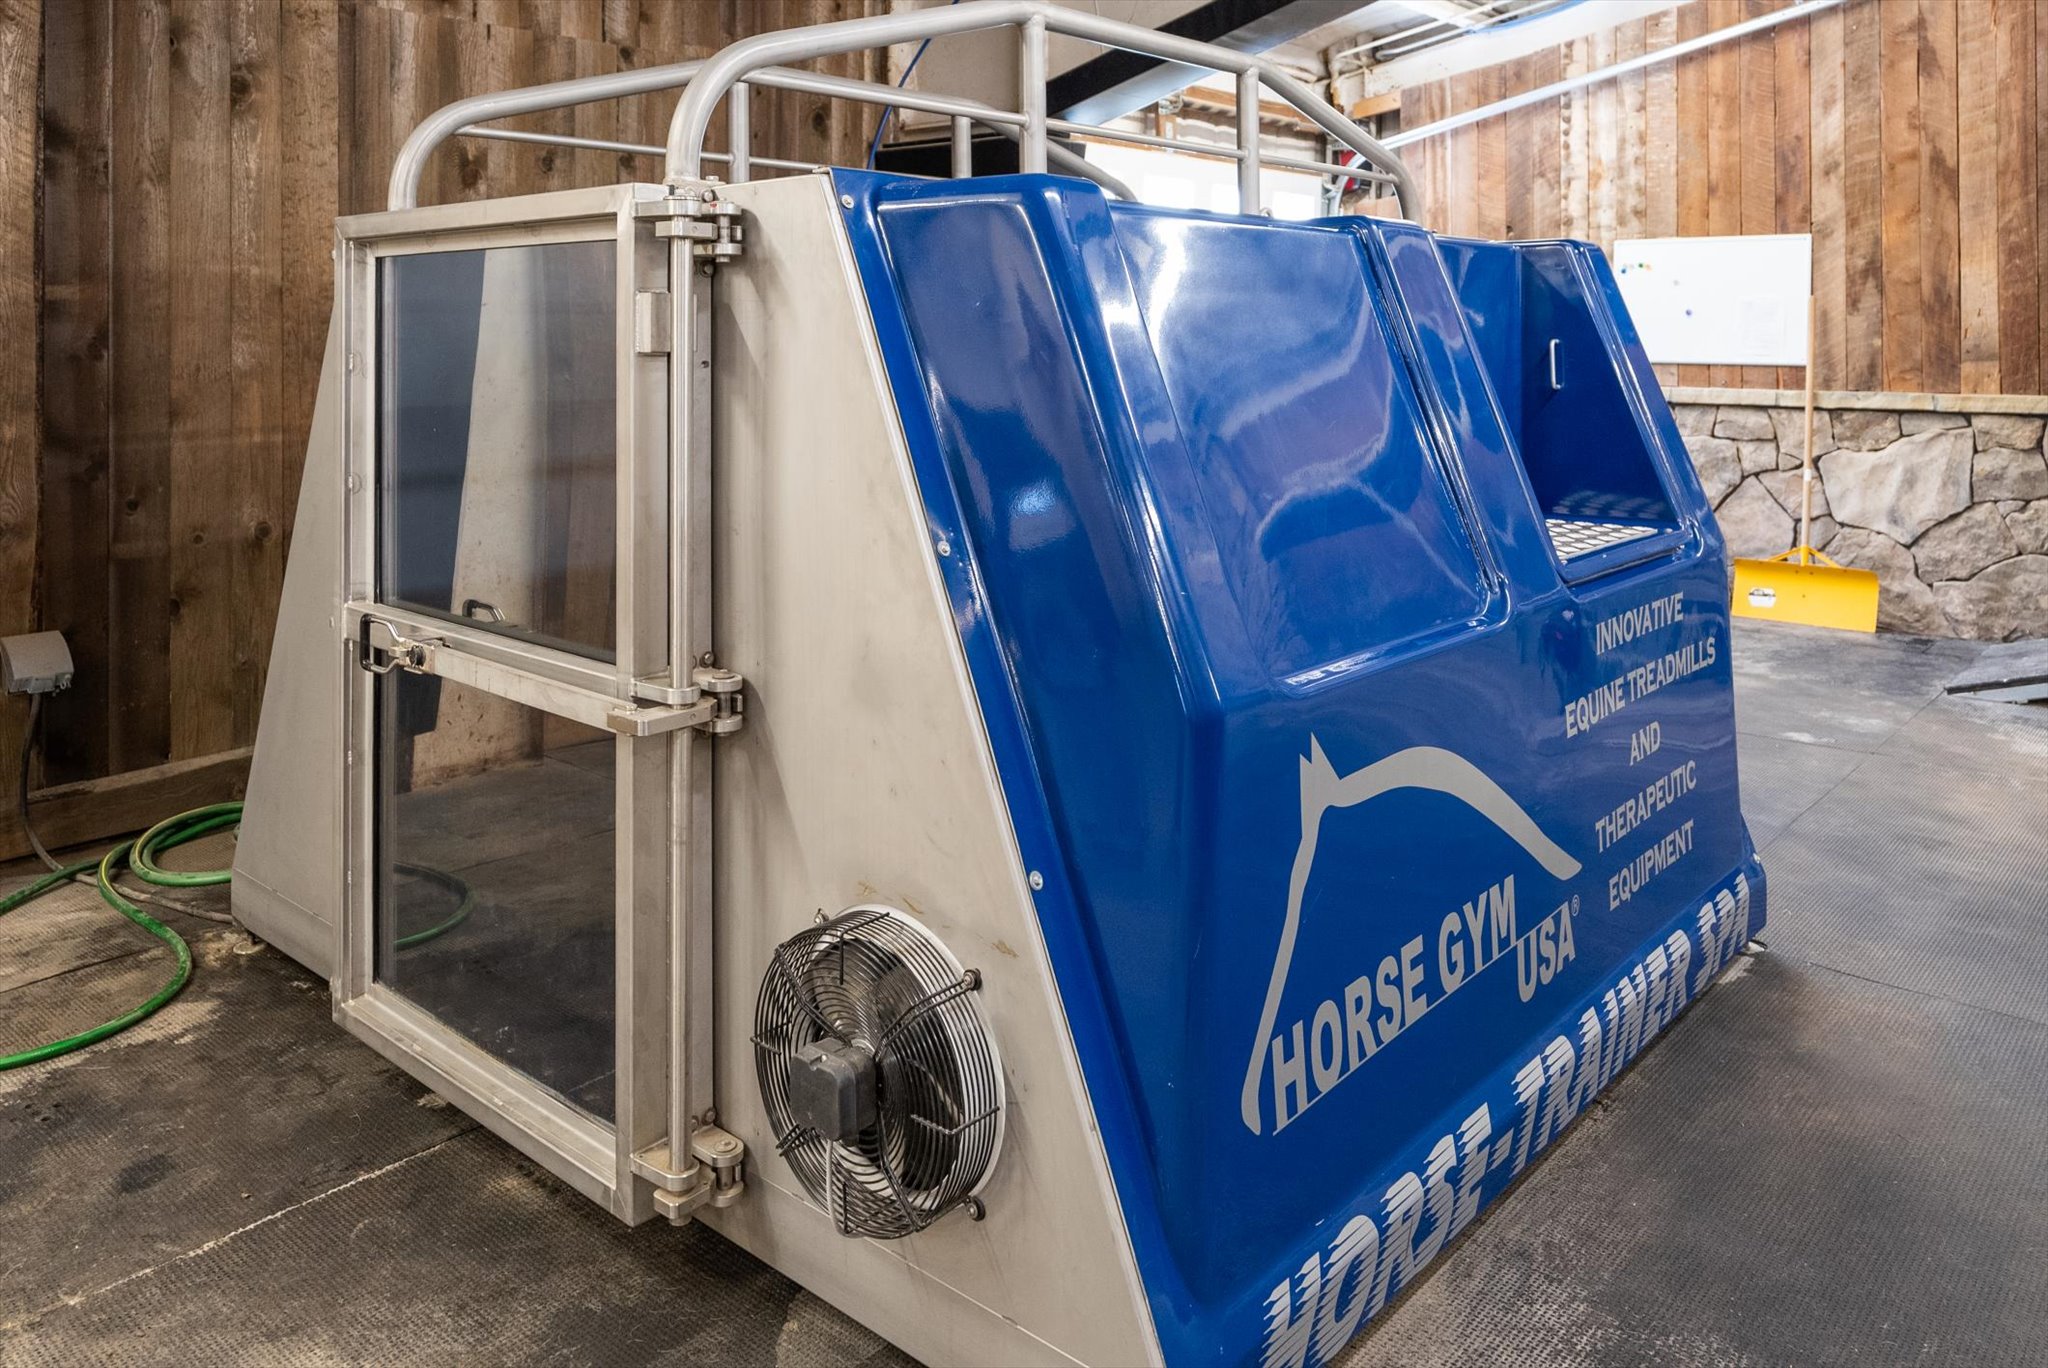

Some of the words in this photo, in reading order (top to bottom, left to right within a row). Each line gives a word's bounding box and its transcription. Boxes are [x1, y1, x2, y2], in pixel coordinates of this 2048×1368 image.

[1595, 592, 1684, 656] INNOVATIVE
[1564, 675, 1626, 738] EQUINE
[1629, 638, 1716, 702] TREADMILLS
[1629, 721, 1661, 766] AND
[1595, 761, 1697, 853] THERAPEUTIC
[1609, 821, 1694, 911] EQUIPMENT
[1692, 872, 1751, 994] SPA
[1271, 935, 1428, 1134] HORSE
[1437, 875, 1518, 995] GYM
